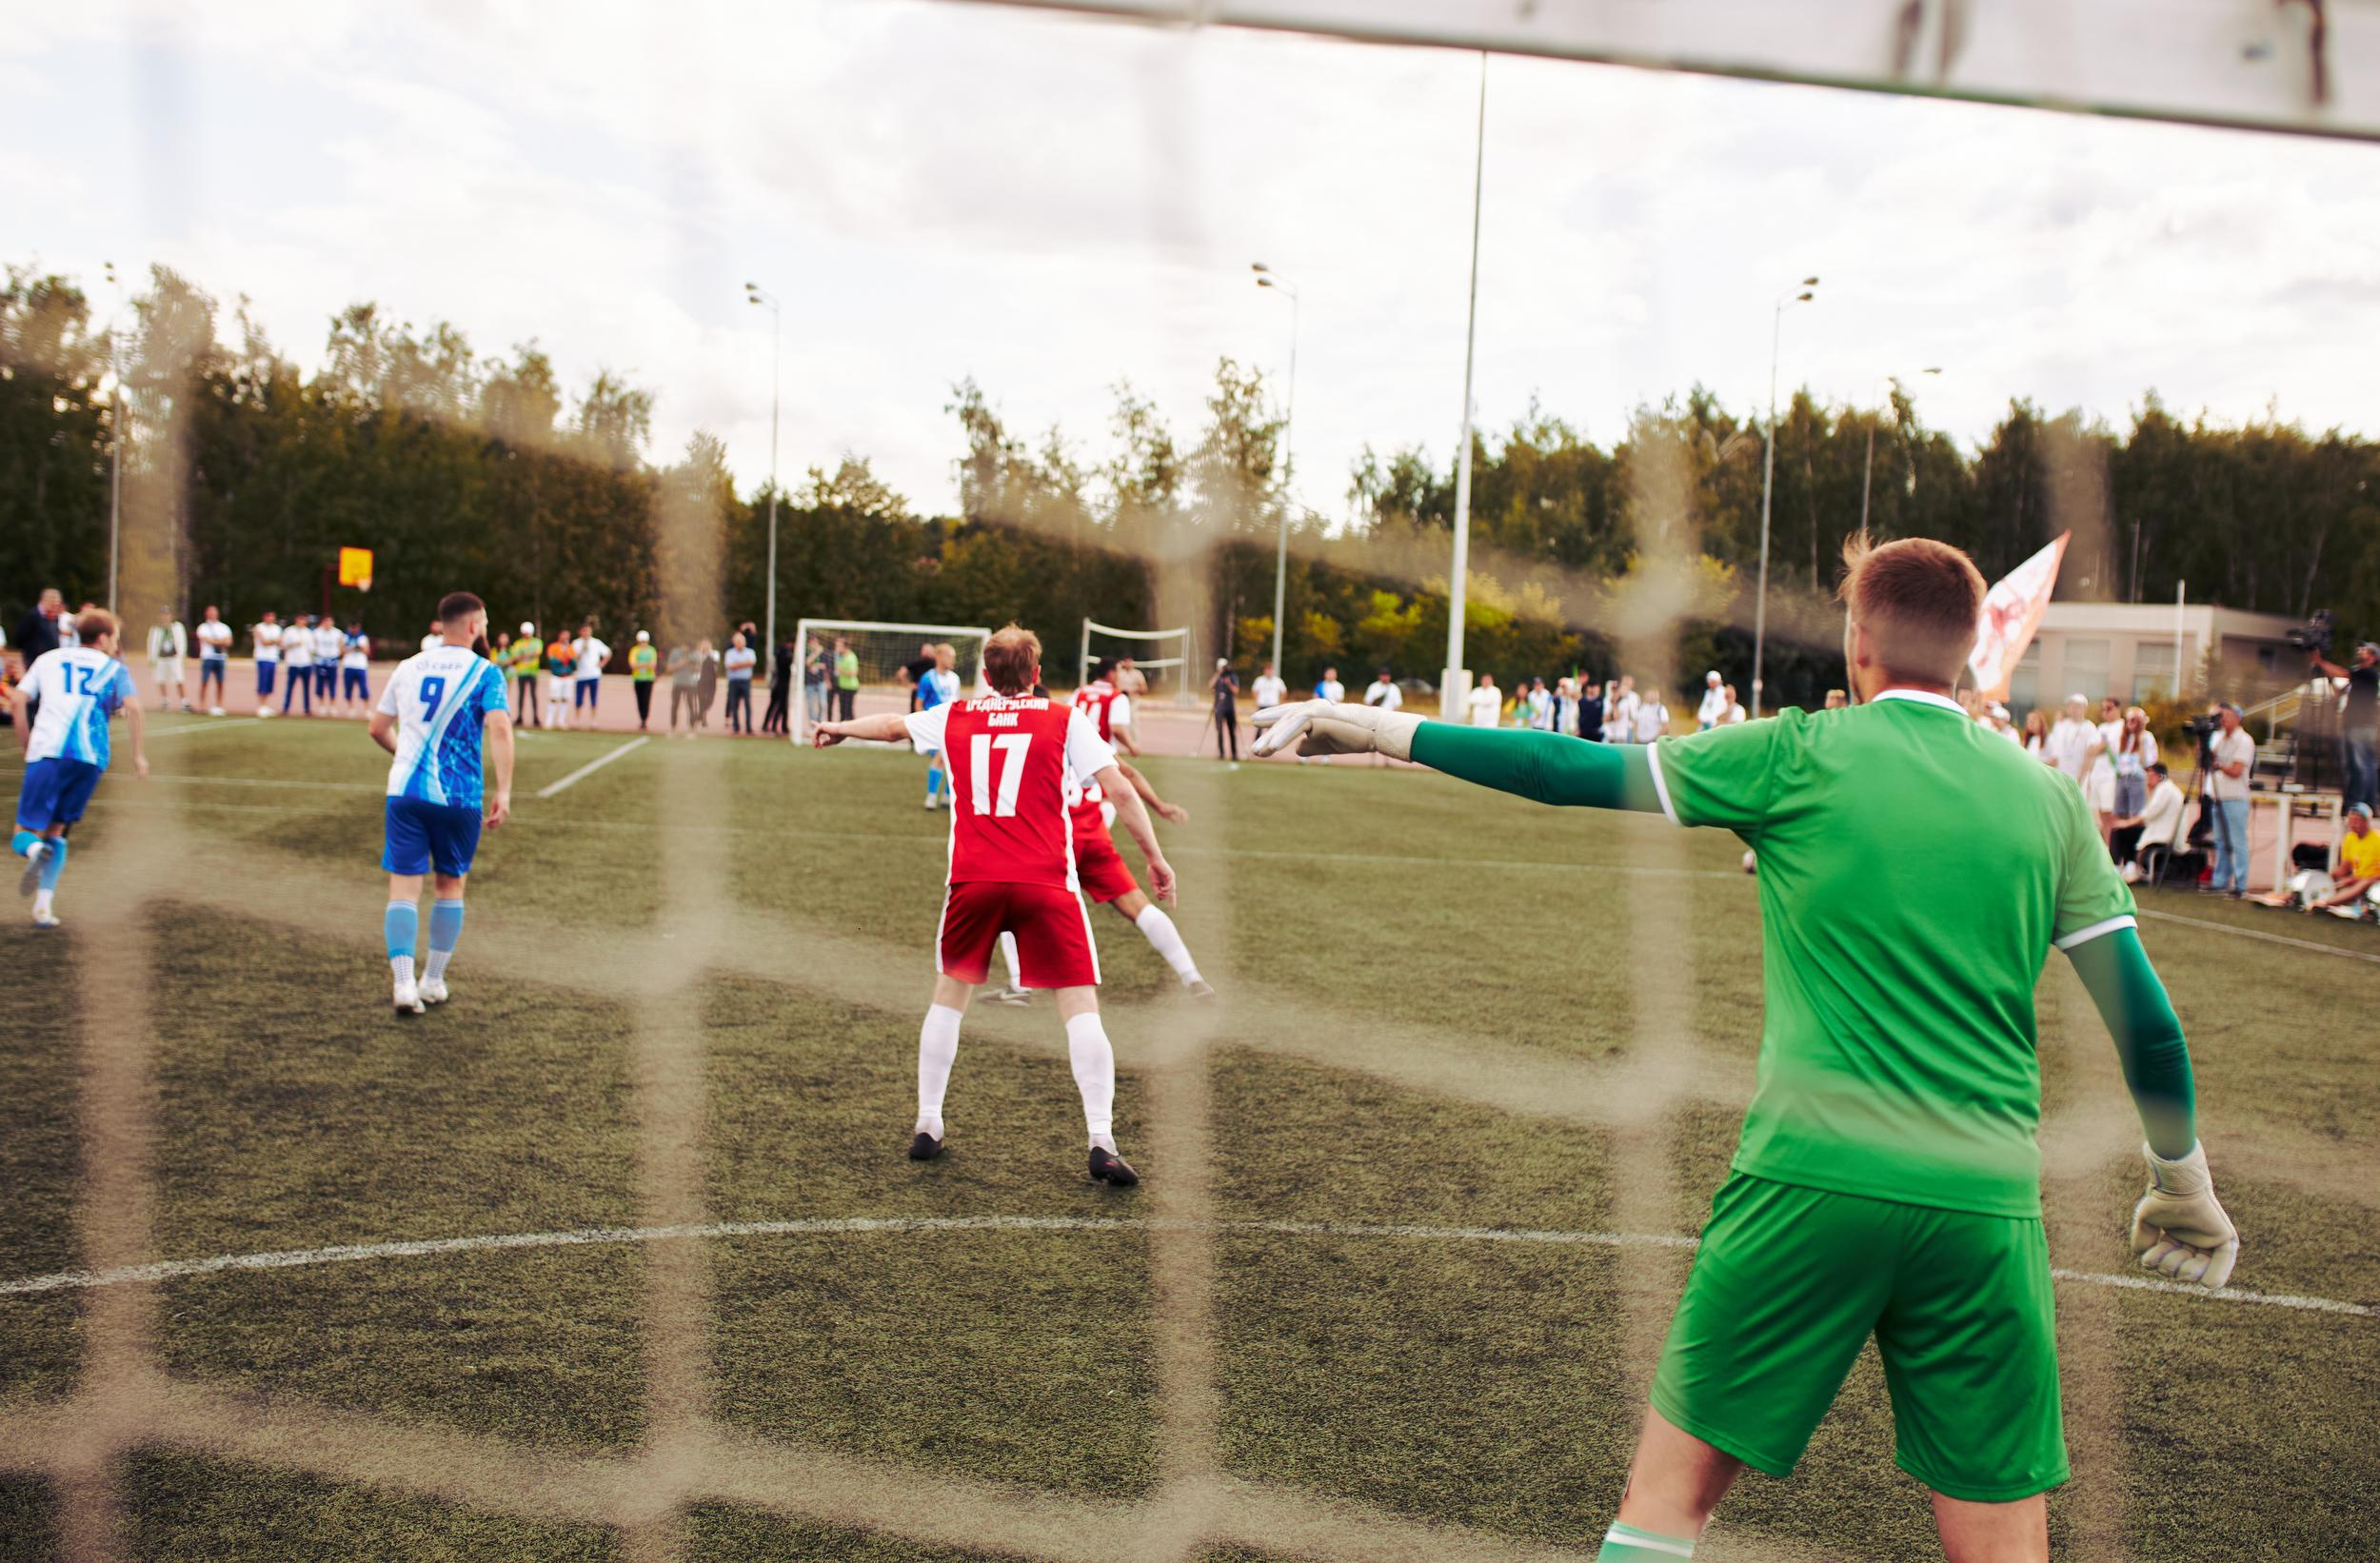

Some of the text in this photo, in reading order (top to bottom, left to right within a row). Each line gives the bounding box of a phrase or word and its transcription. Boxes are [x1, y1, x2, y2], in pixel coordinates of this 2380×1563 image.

[61, 662, 97, 696] 12
[420, 676, 446, 722] 9
[987, 712, 1019, 727] БАНК
[971, 733, 1033, 818] 17
